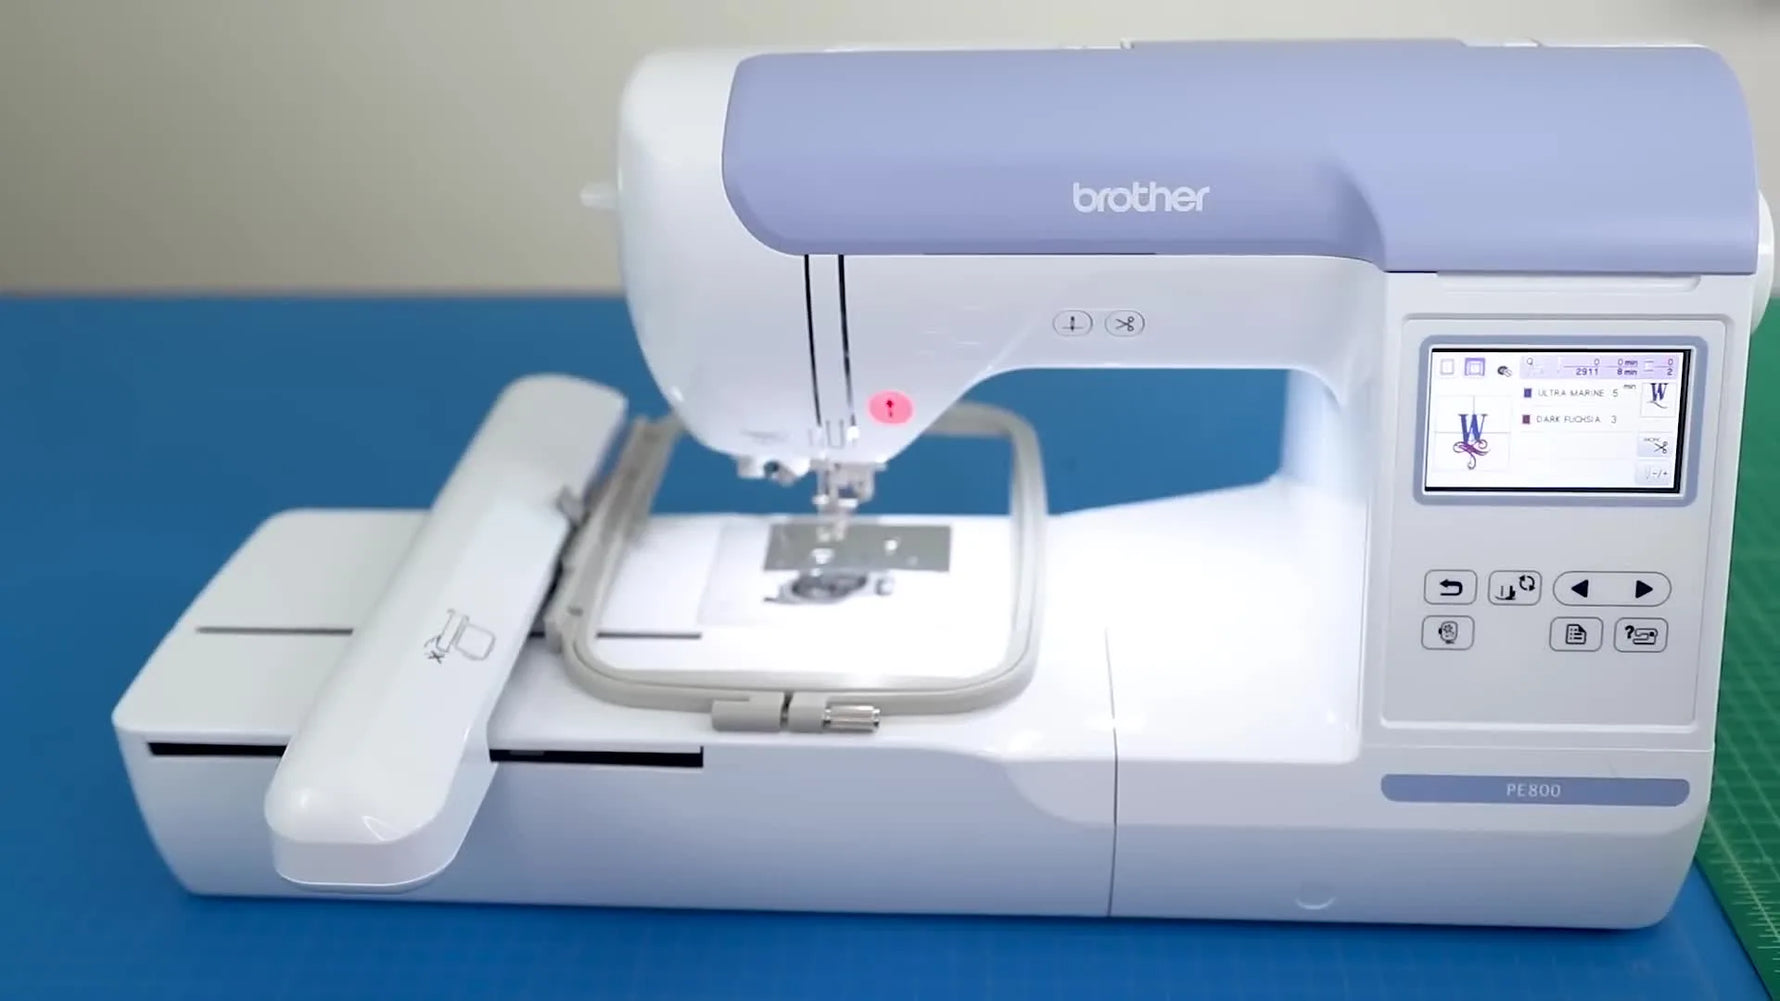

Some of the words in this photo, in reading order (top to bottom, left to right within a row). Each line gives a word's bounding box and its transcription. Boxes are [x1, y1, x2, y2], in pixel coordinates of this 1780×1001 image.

[1073, 181, 1210, 212] brother
[1575, 368, 1599, 376] 2911
[1667, 368, 1673, 376] 2
[1538, 389, 1566, 397] ULTRA
[1570, 389, 1605, 398] MARINE
[1612, 389, 1619, 398] 5
[1536, 415, 1560, 423] DARK
[1564, 415, 1601, 423] FUCHSIA
[1611, 415, 1617, 424] 3
[1506, 783, 1561, 797] PE800
